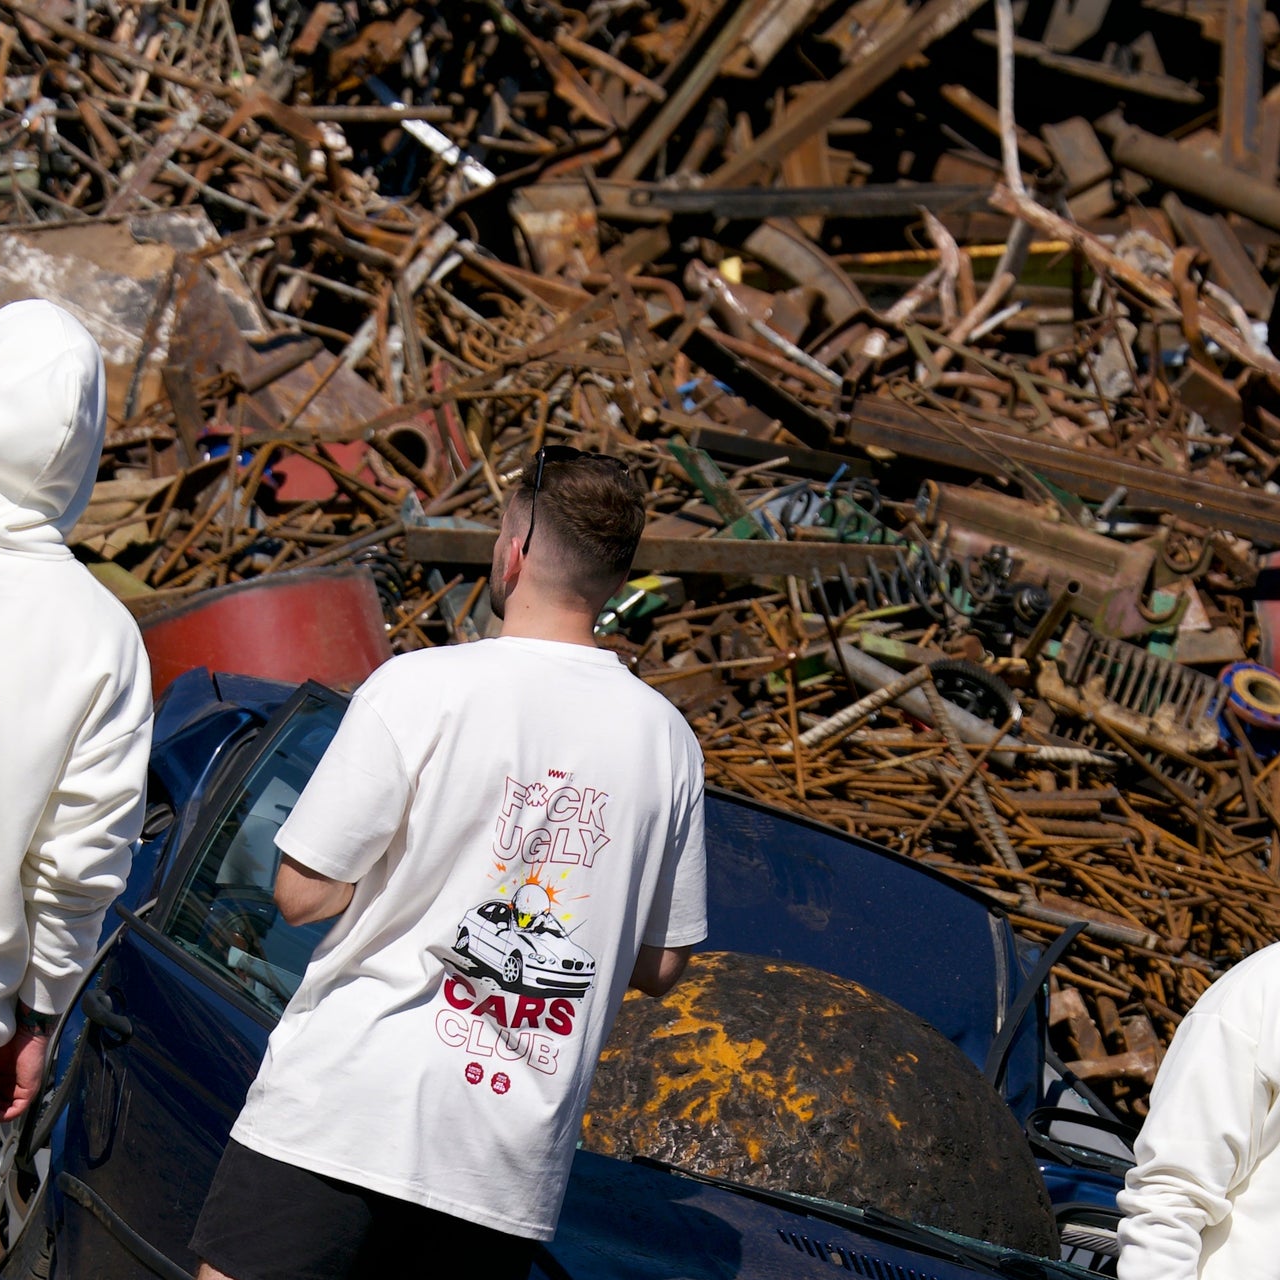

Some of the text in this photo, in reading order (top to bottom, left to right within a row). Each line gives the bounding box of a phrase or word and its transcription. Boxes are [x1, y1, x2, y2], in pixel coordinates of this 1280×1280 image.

[493, 816, 611, 868] UGLY
[444, 973, 575, 1036] CARS
[435, 1008, 559, 1075] CLUB
